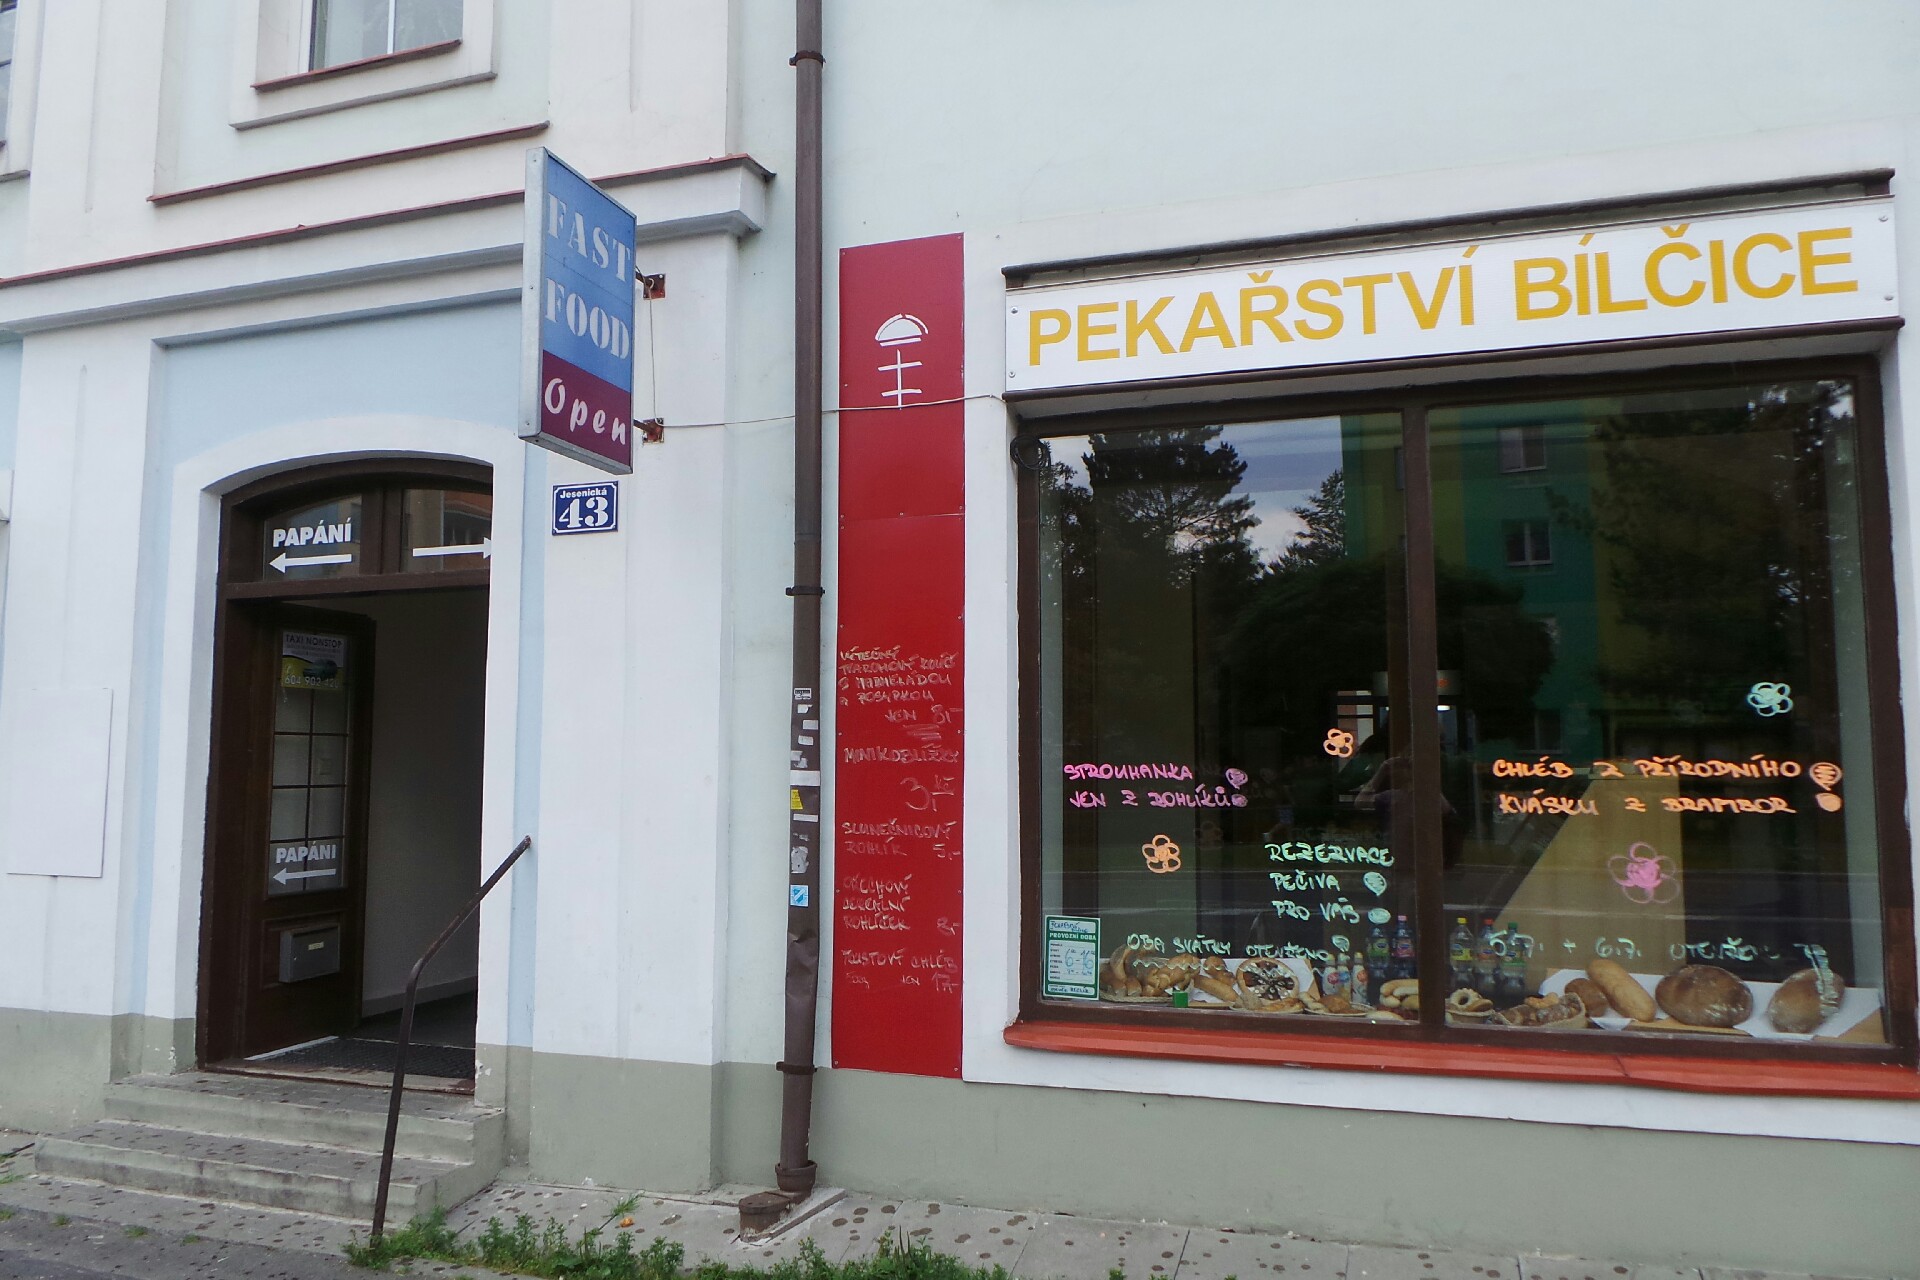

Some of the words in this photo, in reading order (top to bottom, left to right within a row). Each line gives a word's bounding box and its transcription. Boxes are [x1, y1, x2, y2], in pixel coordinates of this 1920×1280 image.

[546, 192, 632, 284] FAST
[1028, 245, 1478, 368] PEKAŘSTVÍ
[1513, 223, 1858, 322] BÍLČICE
[544, 276, 631, 361] FOOD
[543, 376, 628, 447] Open
[559, 487, 607, 499] Jesenická
[558, 496, 608, 529] 43
[272, 516, 352, 548] PAPÁNÍ
[1064, 762, 1192, 781] STROUHANKA
[1492, 757, 1574, 779] CHLÉB
[1633, 754, 1803, 780] PŘÍRODNÍHO
[1069, 790, 1106, 808] JEN
[1121, 789, 1139, 806] Z
[1498, 788, 1598, 816] KVÁSKU
[1660, 797, 1796, 814] BRAMBOR
[1264, 842, 1395, 867] REZERVACE
[1269, 869, 1340, 892] PEČIVA
[1271, 900, 1309, 921] PRO
[1126, 933, 1164, 954] OBA
